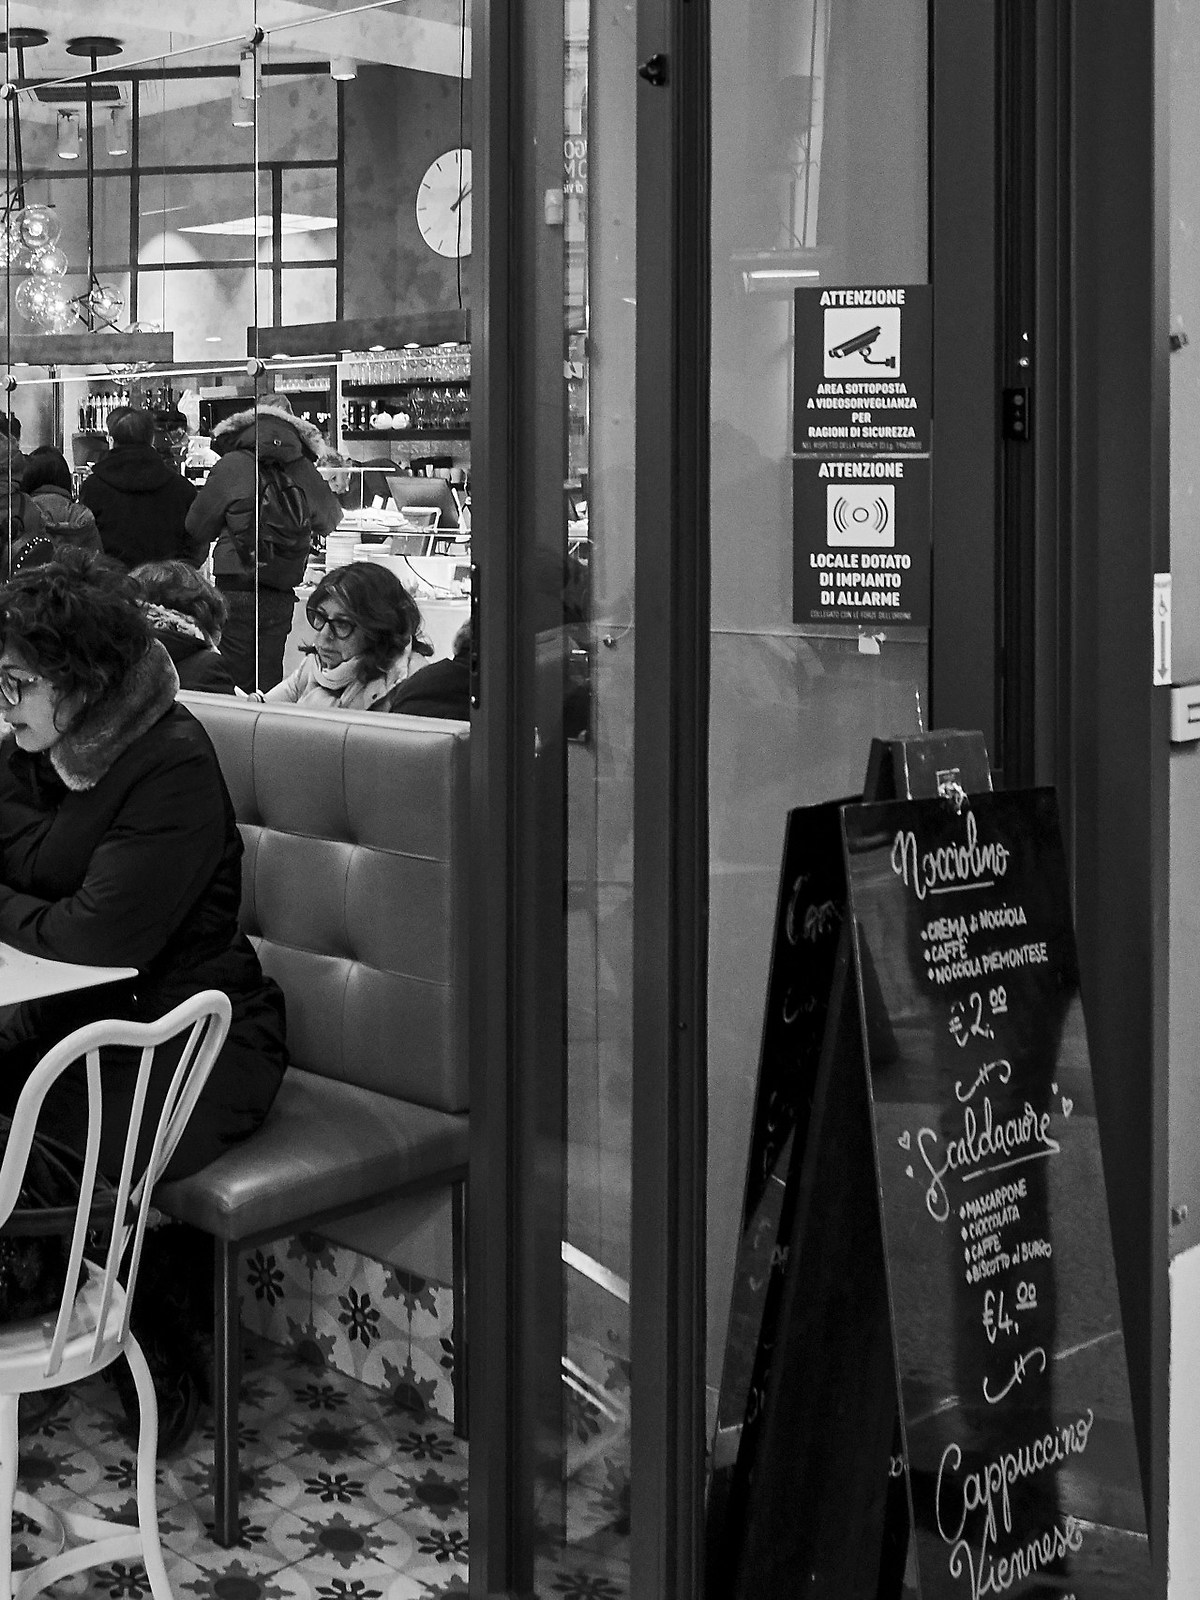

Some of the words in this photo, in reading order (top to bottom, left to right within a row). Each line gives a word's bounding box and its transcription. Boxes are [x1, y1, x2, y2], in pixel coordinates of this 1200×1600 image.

[819, 289, 906, 306] ATTENZIONE
[817, 383, 844, 394] AREA
[845, 383, 907, 394] SOTTOPOSTA
[806, 398, 815, 409] A
[815, 397, 917, 409] VIDEOSORVEGLIANZA
[851, 412, 872, 423] PER
[808, 426, 849, 437] RAGIONI
[850, 426, 861, 438] DI
[862, 426, 916, 438] SICUREZZA
[818, 462, 904, 478] ATTENZIONE
[810, 553, 859, 568] LOCALE
[861, 554, 911, 569] DOTATO
[819, 572, 833, 587] DI
[836, 572, 901, 588] IMPIANTO
[821, 591, 835, 605] DI
[837, 591, 900, 607] ALLARME
[891, 811, 1010, 900] Nocciolino
[927, 915, 969, 941] CREMA
[979, 902, 1027, 930] NOCCIOLA
[935, 957, 982, 984] NOCCIOLA
[982, 942, 1048, 974] PIEMONTESE
[917, 1097, 1060, 1222] Scaldacuore
[965, 1177, 1027, 1220] MASCARPONE
[969, 1204, 1020, 1240] CIOCCOLATA
[971, 1253, 1010, 1282] BISCOTTO
[1022, 1238, 1052, 1262] BURRO
[936, 1408, 1094, 1544] Cappuccino
[950, 1513, 1083, 1600] Viennese
